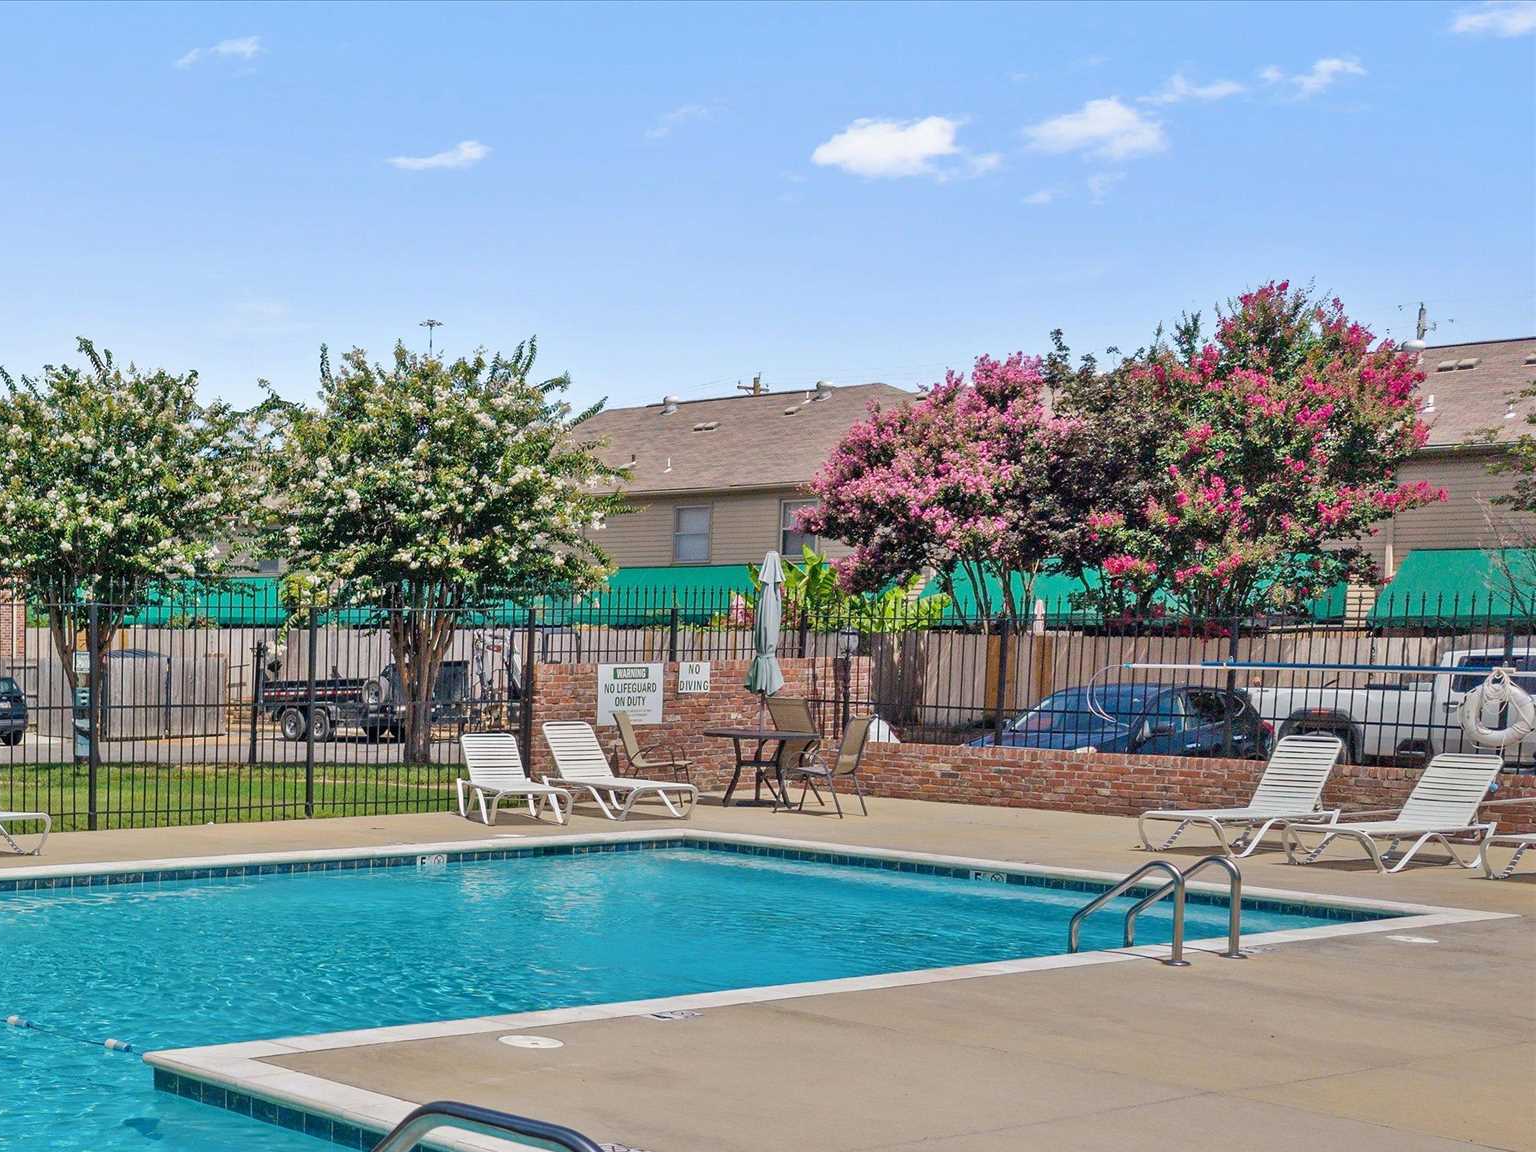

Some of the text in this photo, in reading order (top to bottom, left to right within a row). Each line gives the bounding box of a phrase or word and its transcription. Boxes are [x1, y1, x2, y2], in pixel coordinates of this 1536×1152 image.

[616, 668, 646, 678] WARNING
[689, 664, 700, 674] NO
[604, 682, 657, 693] NO LIFEGUARD
[680, 680, 708, 691] DIVING
[615, 696, 646, 706] ON DUTY
